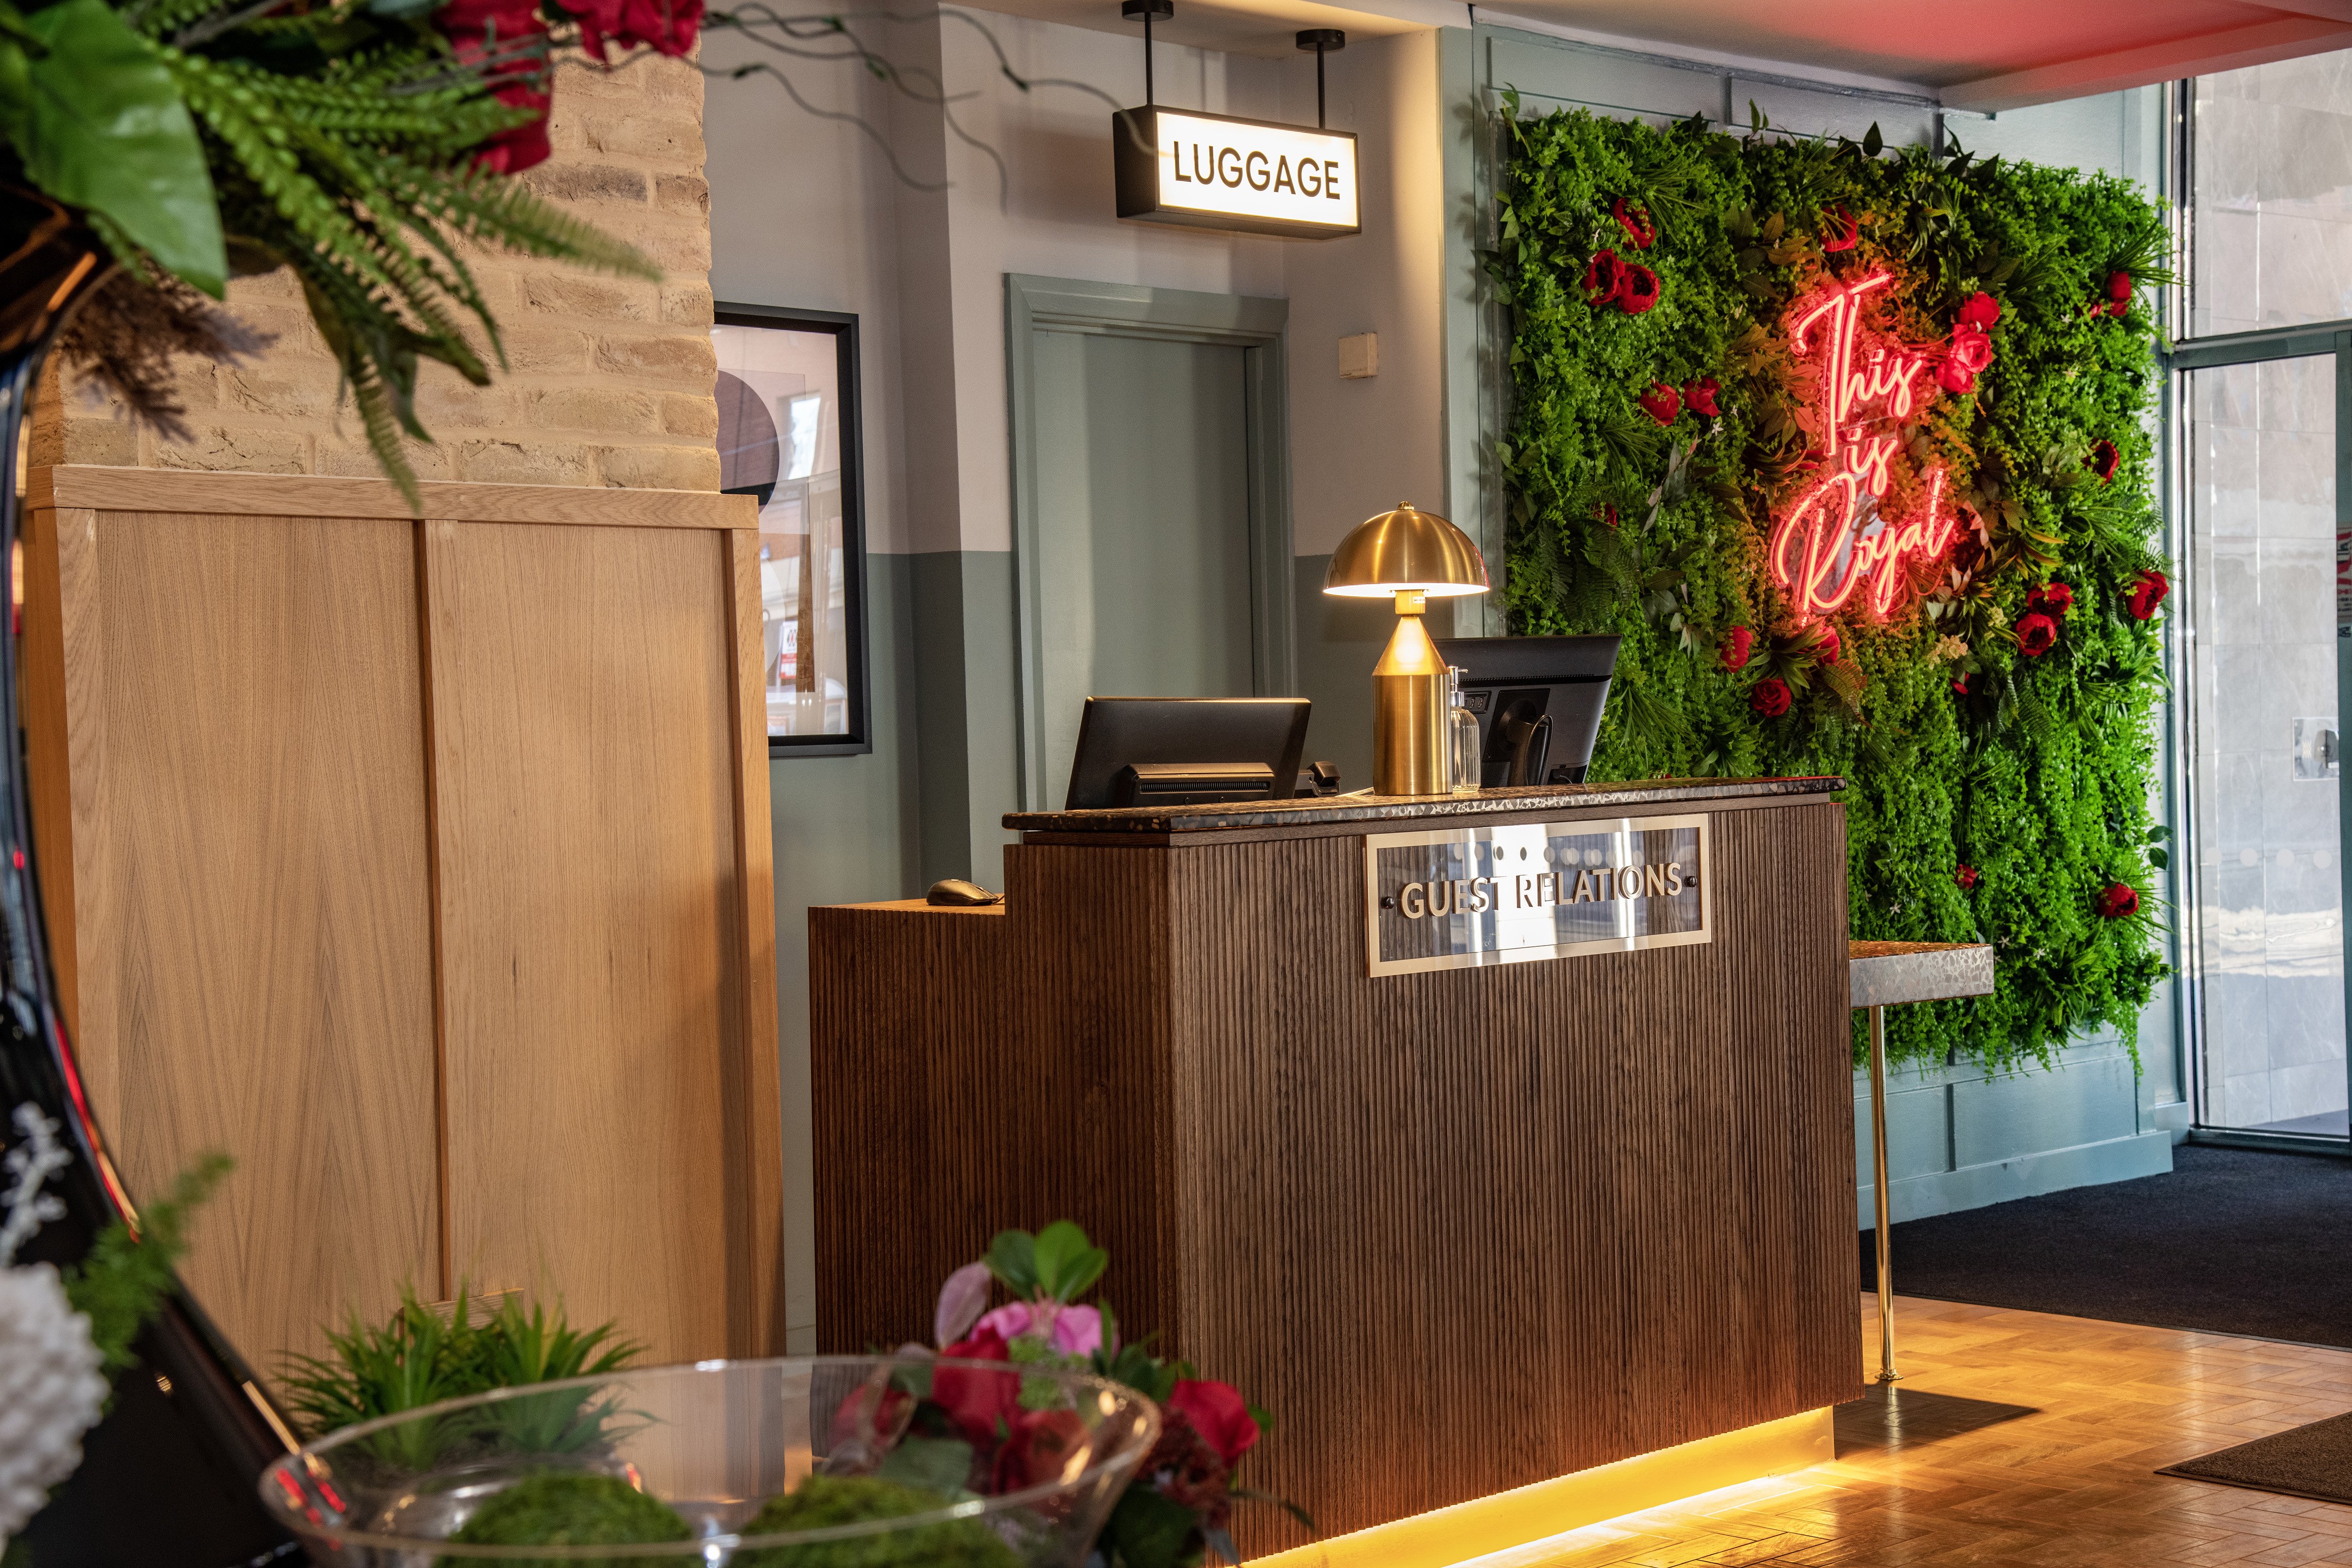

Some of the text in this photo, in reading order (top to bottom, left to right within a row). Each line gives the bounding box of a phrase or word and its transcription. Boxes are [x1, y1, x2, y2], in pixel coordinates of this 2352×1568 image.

[1173, 140, 1341, 200] LUGGAGE
[1793, 273, 1923, 456] This
[1844, 427, 1899, 496] is
[1773, 469, 1954, 614] Royal
[1400, 862, 1683, 920] GUEST RELATIONS
